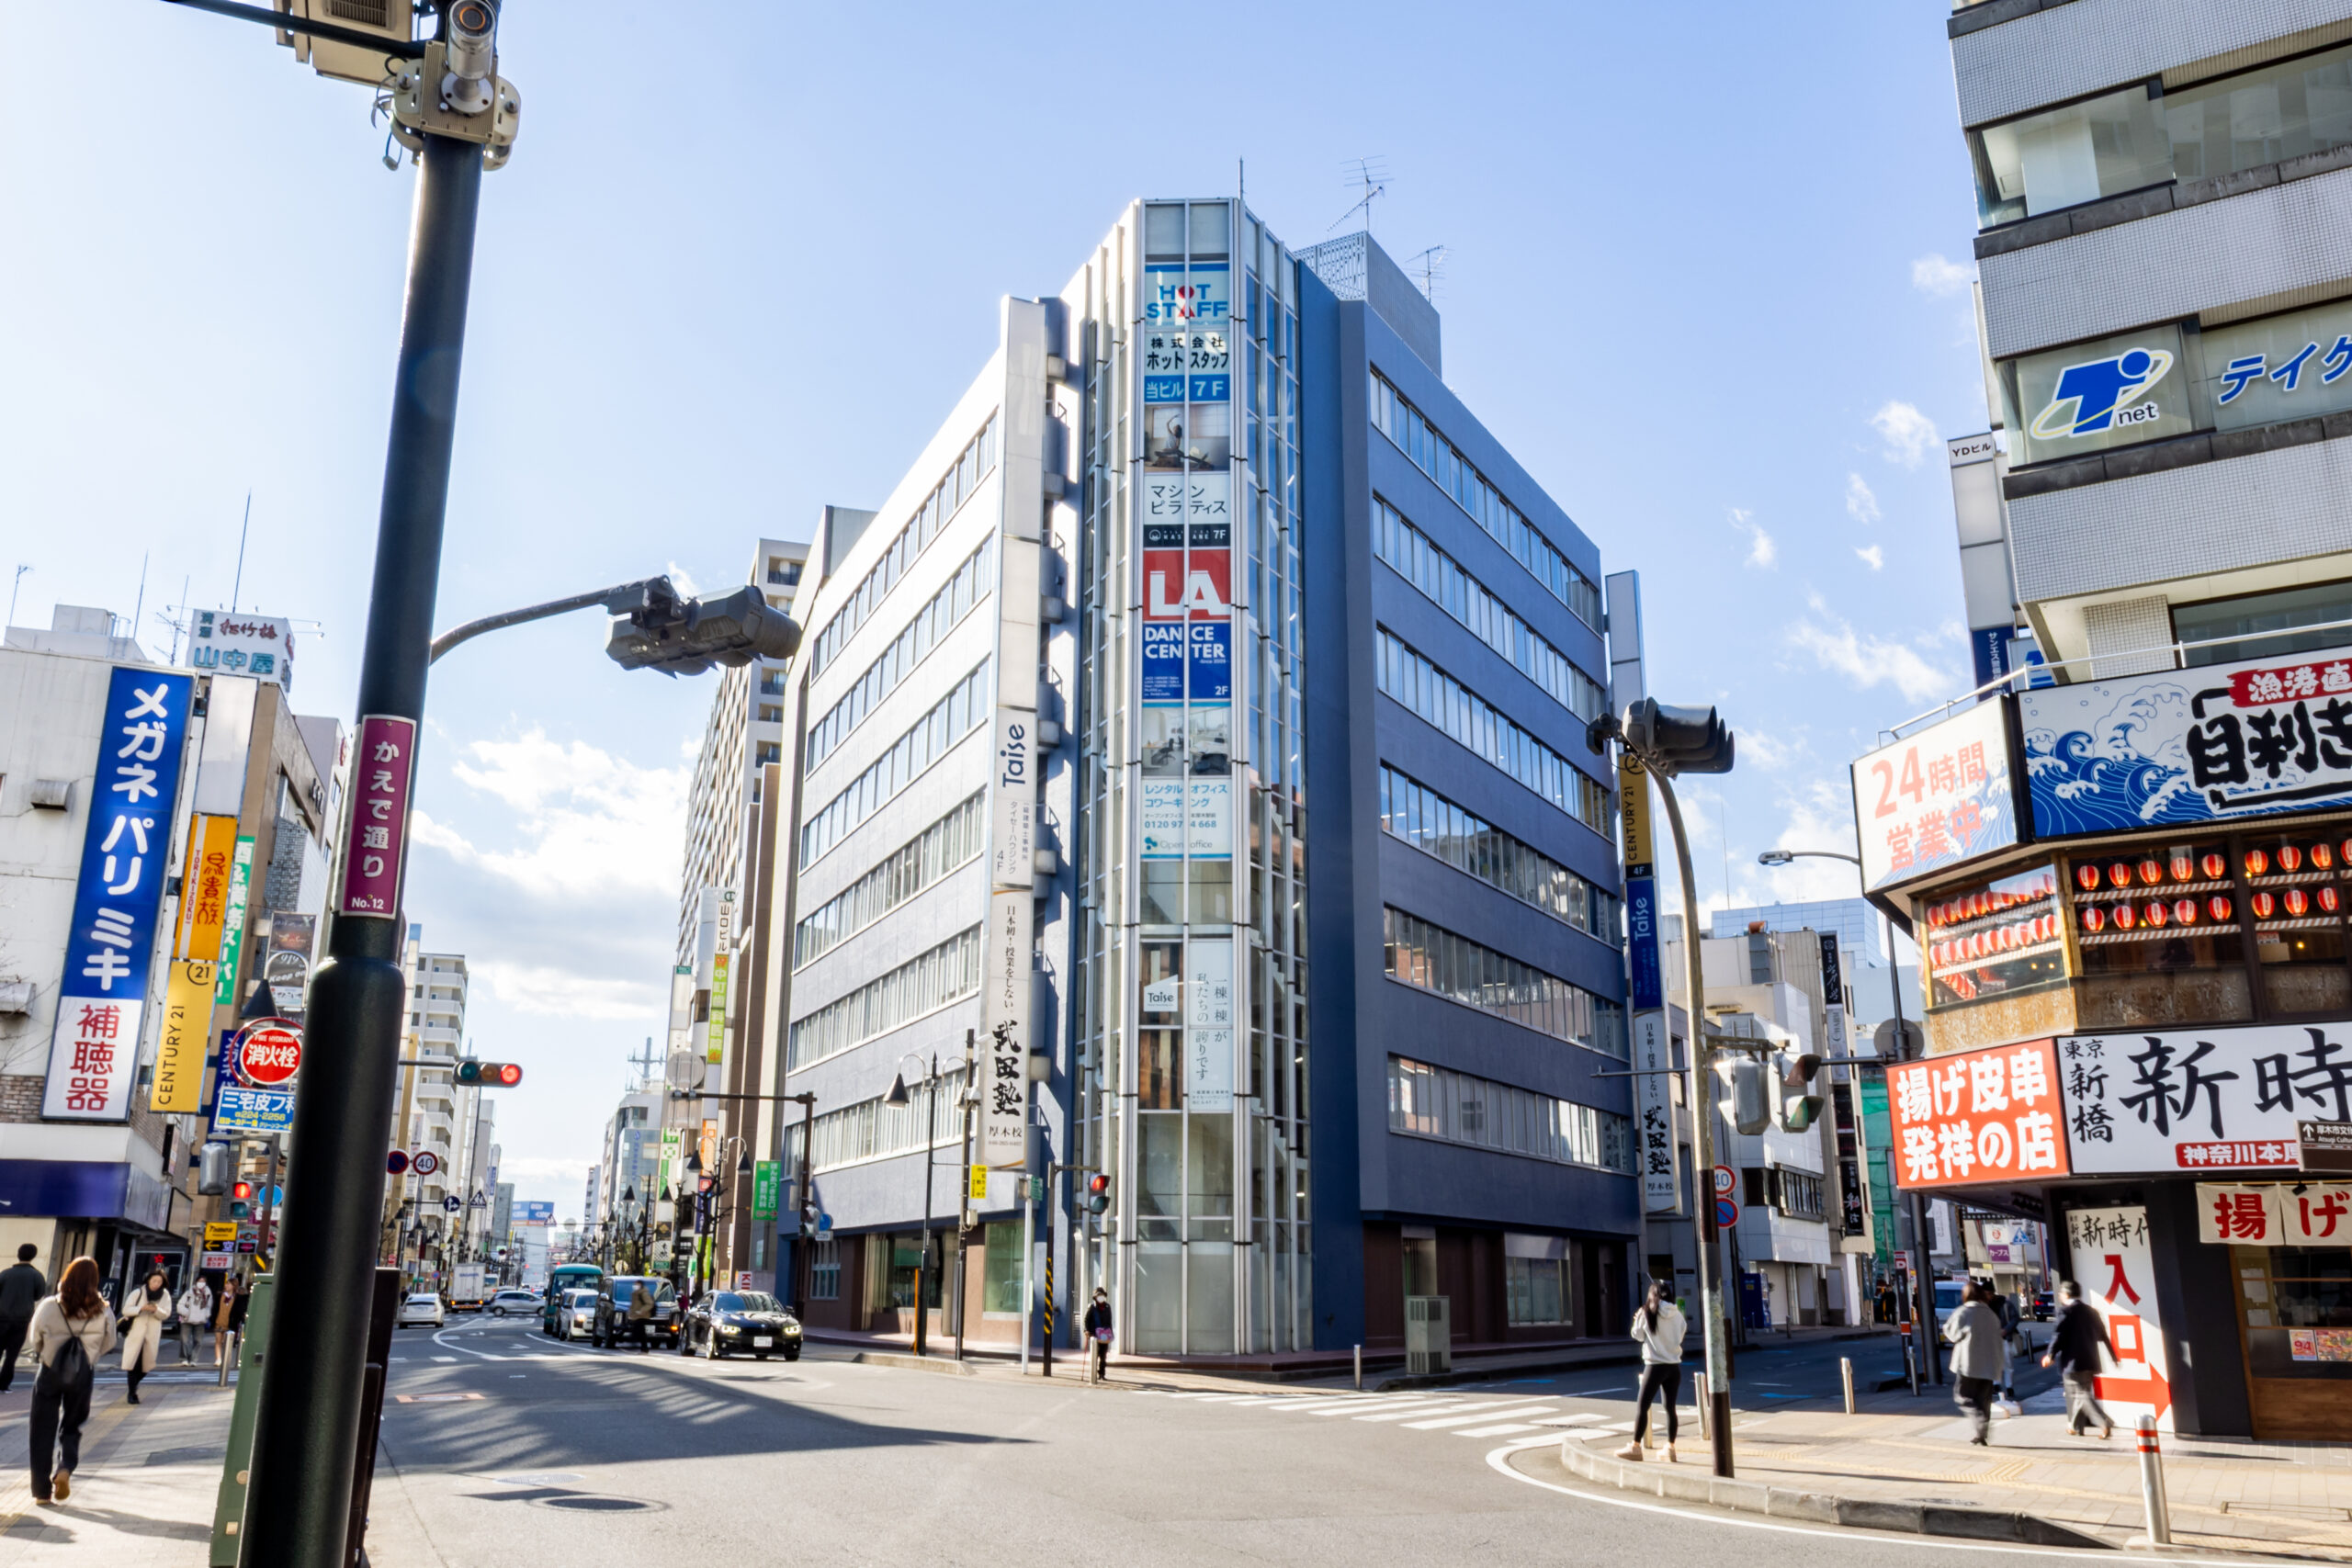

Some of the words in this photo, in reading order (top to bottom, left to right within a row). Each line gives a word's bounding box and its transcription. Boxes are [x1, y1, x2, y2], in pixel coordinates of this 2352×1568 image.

[1159, 285, 1211, 300] HOT
[1147, 301, 1227, 318] STAFF
[1151, 336, 1223, 349] 株式会社
[1148, 351, 1228, 369] ホットスタッフ
[1147, 381, 1184, 399] 当ビル
[2117, 403, 2158, 426] net
[1150, 485, 1205, 498] マシン
[1151, 500, 1227, 514] ピラティス
[1213, 529, 1227, 539] 7F
[1149, 570, 1231, 616] LA
[1145, 626, 1215, 641] DANCE
[193, 646, 275, 674] 山中屋
[1145, 644, 1226, 659] CENTER
[1215, 686, 1228, 695] 2F
[1000, 724, 1026, 787] Taise
[362, 741, 399, 877] かえで通り
[1145, 797, 1210, 807] コワーキング
[1625, 800, 1638, 861] CENTURY
[1886, 800, 1982, 873] 営業中
[1634, 866, 1645, 874] 4F
[718, 904, 730, 952] 山口ビル
[1629, 897, 1651, 941] Taise
[1148, 992, 1174, 1003] Taise
[268, 1035, 294, 1043] HYDRANT
[2064, 1038, 2105, 1059] 東京
[66, 1005, 119, 1111] 補聴器
[158, 1024, 182, 1105] CENTURY
[246, 1043, 299, 1067] 消火栓
[991, 1020, 1023, 1116] 武田塾
[1896, 1047, 2048, 1123] 揚げ皮串
[2066, 1062, 2114, 1145] 新橋
[989, 1126, 1023, 1138] 厚木校
[1643, 1106, 1670, 1175] 武田塾
[1903, 1111, 2057, 1182] 発祥の店
[417, 1157, 433, 1169] 40
[1647, 1181, 1673, 1190] 厚木校
[1715, 1173, 1729, 1187] 40
[2104, 1254, 2145, 1364] 入口
